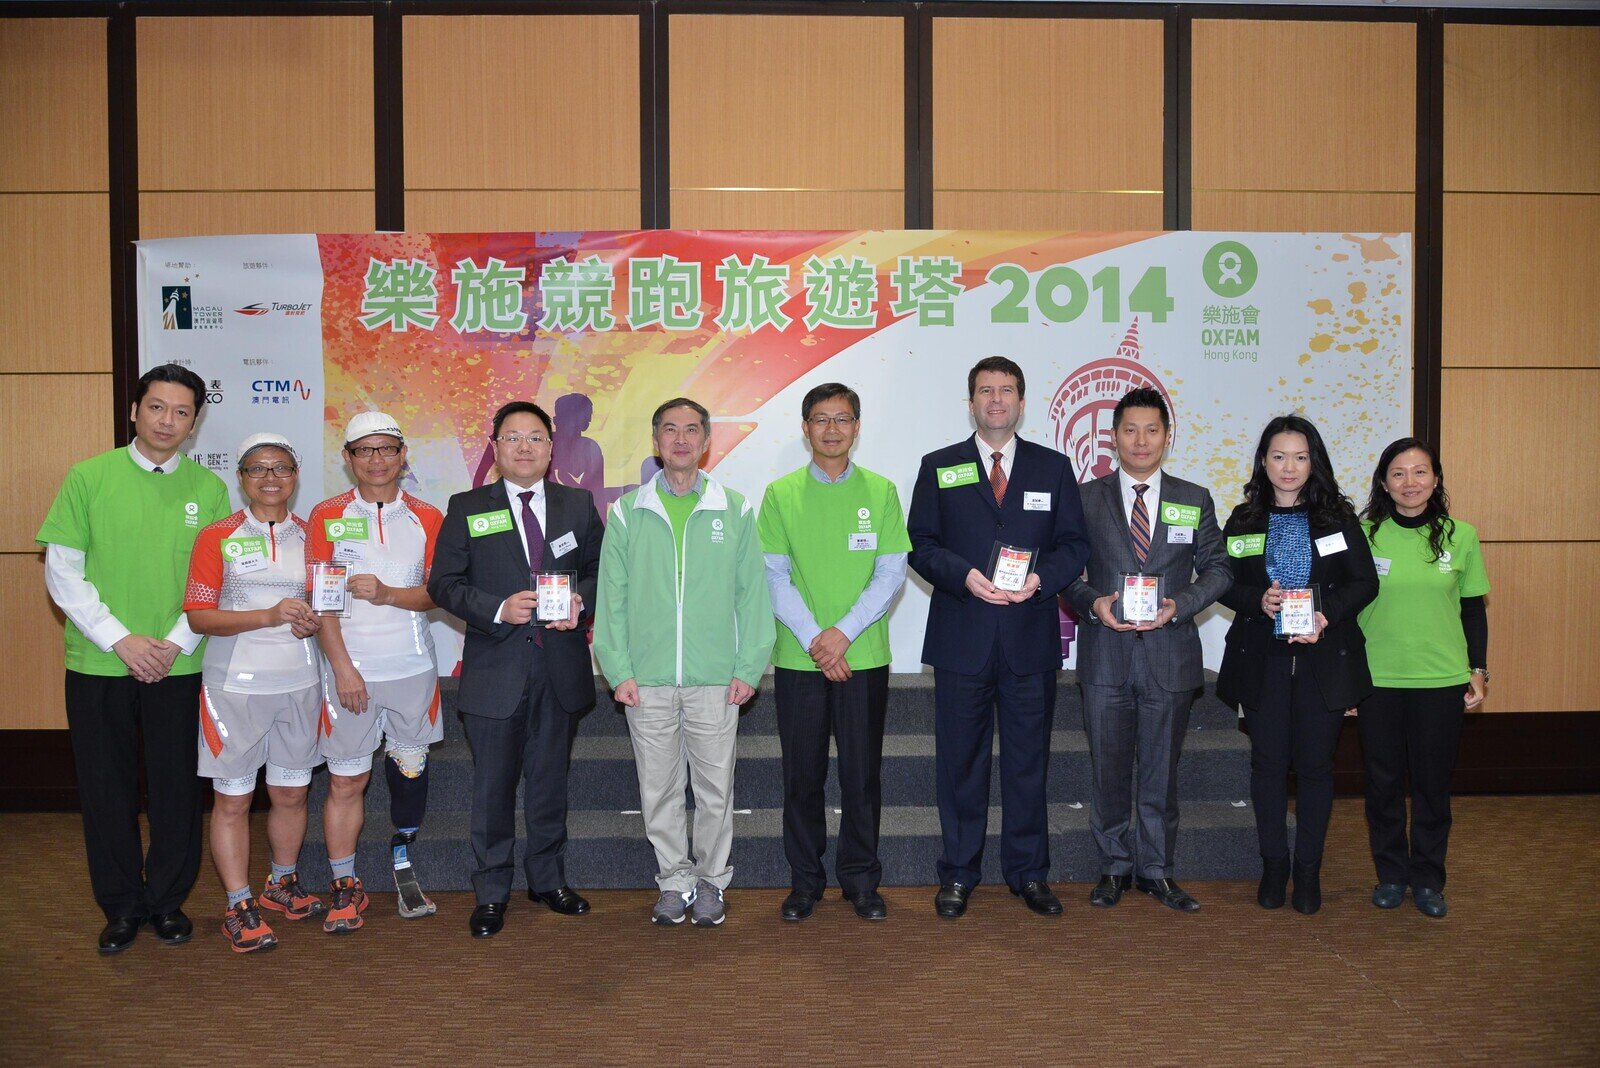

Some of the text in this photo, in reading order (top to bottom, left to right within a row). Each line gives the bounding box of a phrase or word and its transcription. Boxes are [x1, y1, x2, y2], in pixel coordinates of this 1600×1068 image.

[360, 257, 1175, 333] 樂施競跑旅遊塔 2014
[1202, 304, 1261, 325] 樂施會
[1201, 328, 1260, 346] OXFAM
[1203, 349, 1258, 363] Hong Kong
[251, 380, 290, 392] CTM
